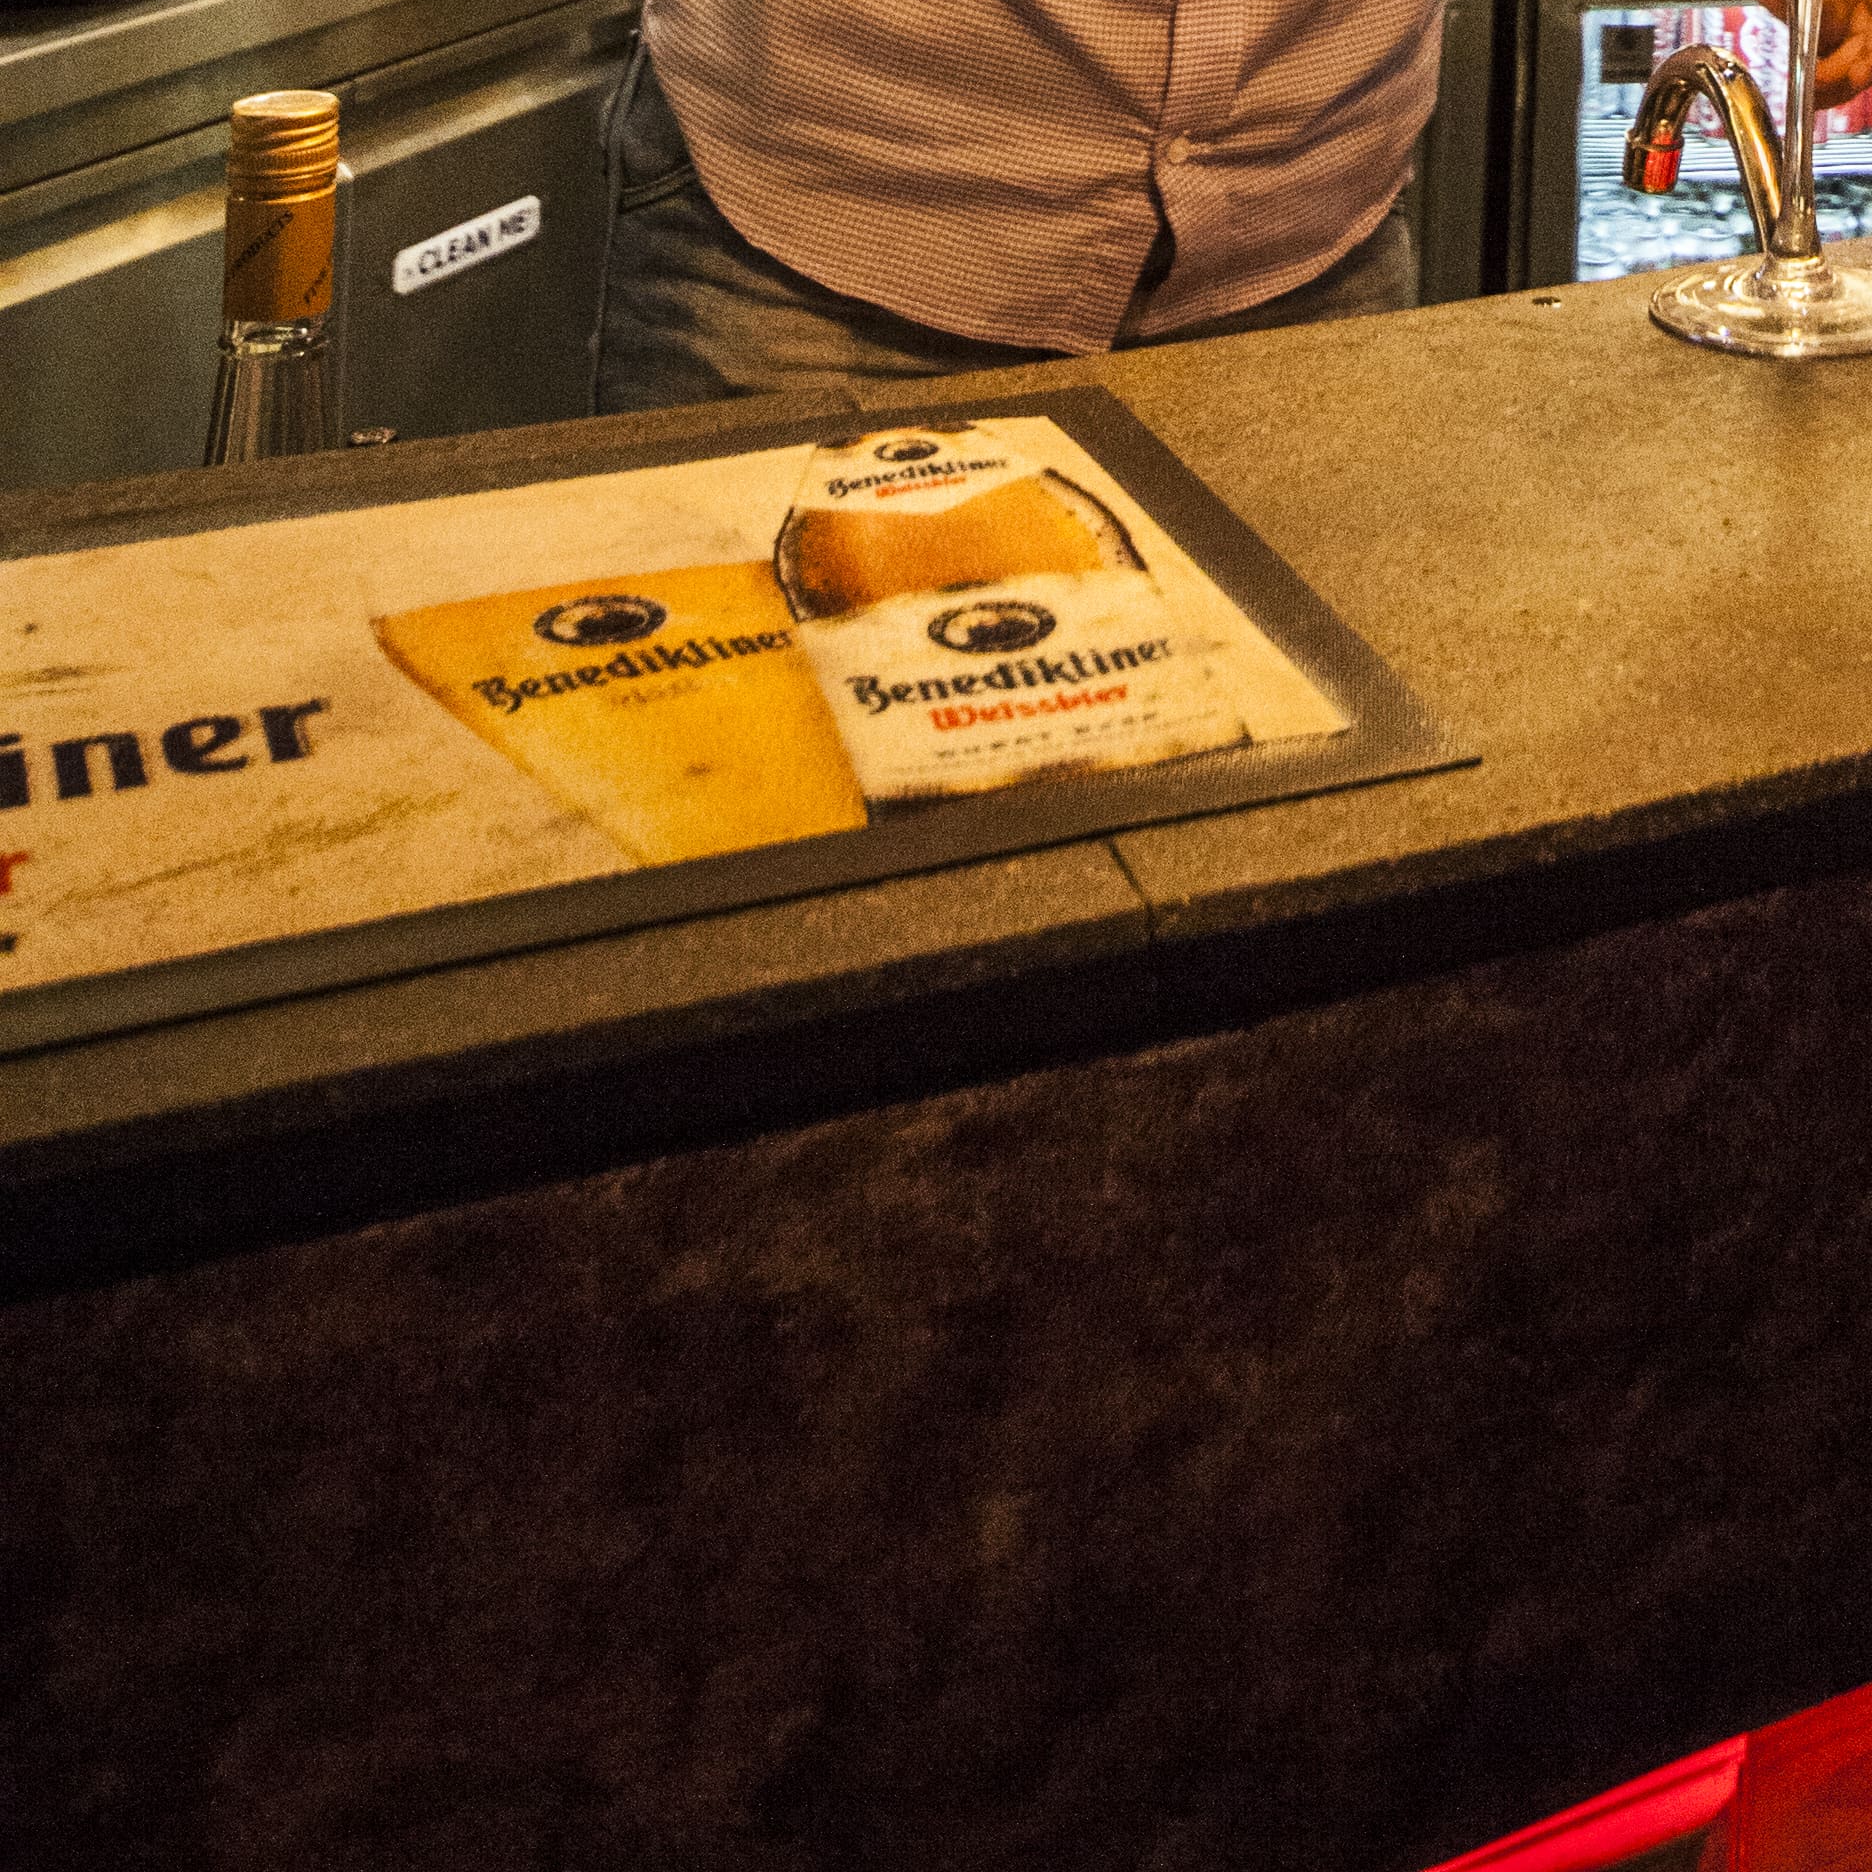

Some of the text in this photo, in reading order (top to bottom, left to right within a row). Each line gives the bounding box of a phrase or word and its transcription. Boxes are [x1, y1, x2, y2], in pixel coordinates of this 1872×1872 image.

[417, 223, 493, 276] CLEAN
[825, 458, 1008, 499] Benediktiner
[471, 629, 793, 715] Benediktiner
[845, 637, 1174, 716] Benediktiner
[928, 683, 1130, 733] Weissbier
